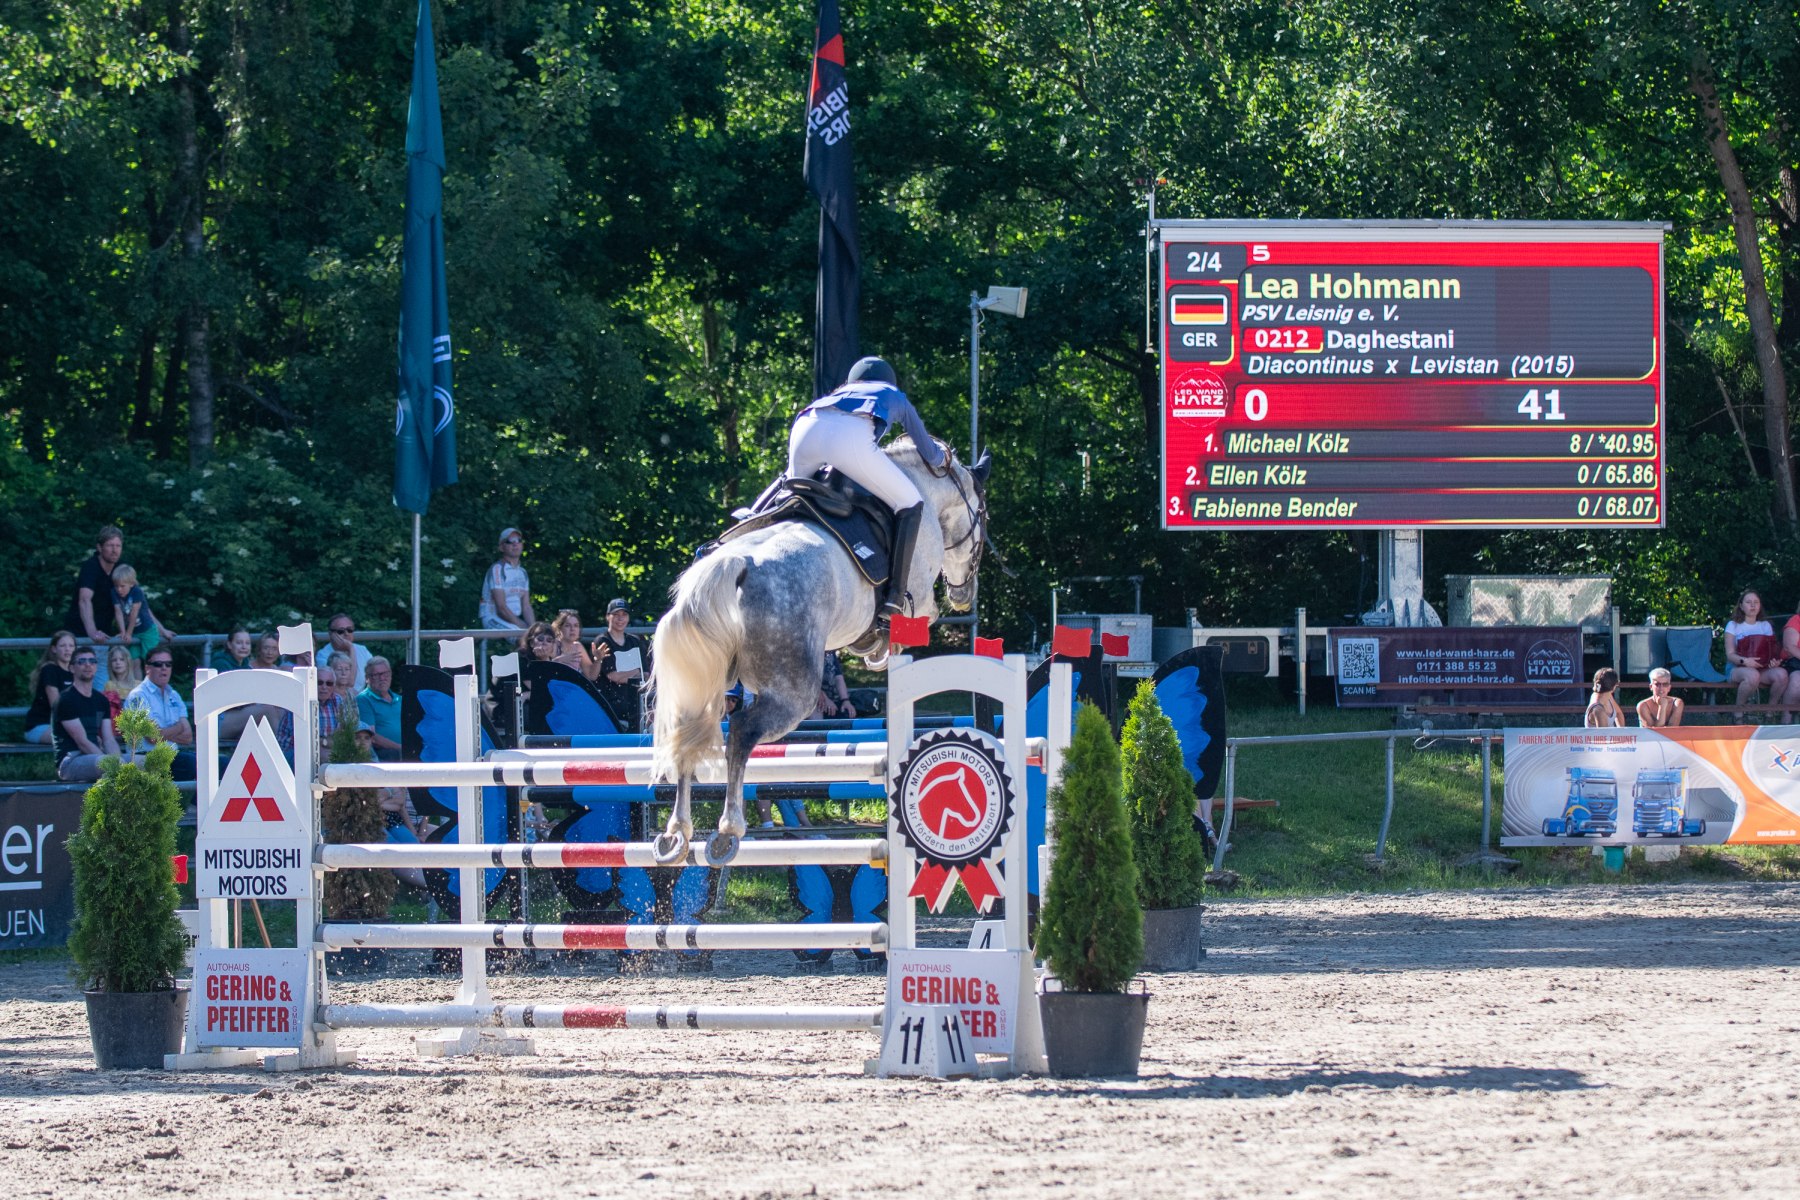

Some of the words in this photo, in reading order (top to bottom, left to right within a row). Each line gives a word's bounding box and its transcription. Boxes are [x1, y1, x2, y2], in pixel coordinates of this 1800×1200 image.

[1187, 251, 1222, 272] 2/4
[1252, 245, 1270, 261] 5
[1245, 273, 1298, 298] Lea
[1310, 272, 1460, 298] Hohmann
[1242, 305, 1282, 321] PSV
[1284, 304, 1354, 324] Leisnig
[1358, 308, 1374, 321] e.
[1382, 305, 1400, 321] V.
[1182, 332, 1218, 347] GER
[1254, 330, 1310, 348] 0212
[1327, 330, 1454, 353] Daghestani
[1248, 355, 1374, 374] Diacontinus
[1385, 360, 1398, 374] x
[1410, 355, 1499, 374] Levistan
[1512, 355, 1575, 378] (2015)
[1174, 395, 1224, 406] HARZ
[1244, 389, 1268, 421] 0
[1518, 389, 1566, 420] 41
[1204, 433, 1218, 452] 1.
[1228, 433, 1302, 453] Michael
[1306, 433, 1350, 453] Kölz
[1185, 466, 1200, 485] 2.
[1210, 465, 1258, 485] Ellen
[1264, 465, 1307, 485] Kölz
[1168, 496, 1184, 516] 3.
[1194, 497, 1282, 518] Fabienne
[1288, 497, 1358, 518] Bender
[1396, 649, 1515, 658] www.led-wand-harz.de
[1416, 662, 1440, 670] 0171
[1445, 662, 1464, 670] 388
[1468, 662, 1480, 670] 55
[1484, 662, 1496, 670] 23
[1528, 666, 1570, 675] HARZ
[1398, 675, 1515, 684] info@led-wand-harz.de
[1344, 686, 1364, 694] SCAN
[1366, 686, 1376, 694] ME
[1518, 736, 1542, 744] FAHREN
[1544, 736, 1553, 744] SIE
[1556, 736, 1568, 744] MIT
[1570, 736, 1583, 744] UNS
[911, 750, 957, 786] MITSUBISHI
[960, 752, 994, 786] MOTORS
[949, 844, 966, 852] den
[969, 802, 996, 846] Reitsport
[204, 848, 300, 869] MITSUBISHI
[218, 876, 288, 896] MOTORS
[206, 964, 250, 972] AUTOHAUS
[902, 964, 952, 973] AUTOHAUS
[206, 975, 276, 1001] GERING
[280, 981, 292, 1002] &
[902, 976, 982, 1004] GERING
[986, 984, 1000, 1006] &
[208, 1006, 290, 1032] PFEIFFER
[900, 1016, 924, 1064] 11
[942, 1015, 966, 1064] 11
